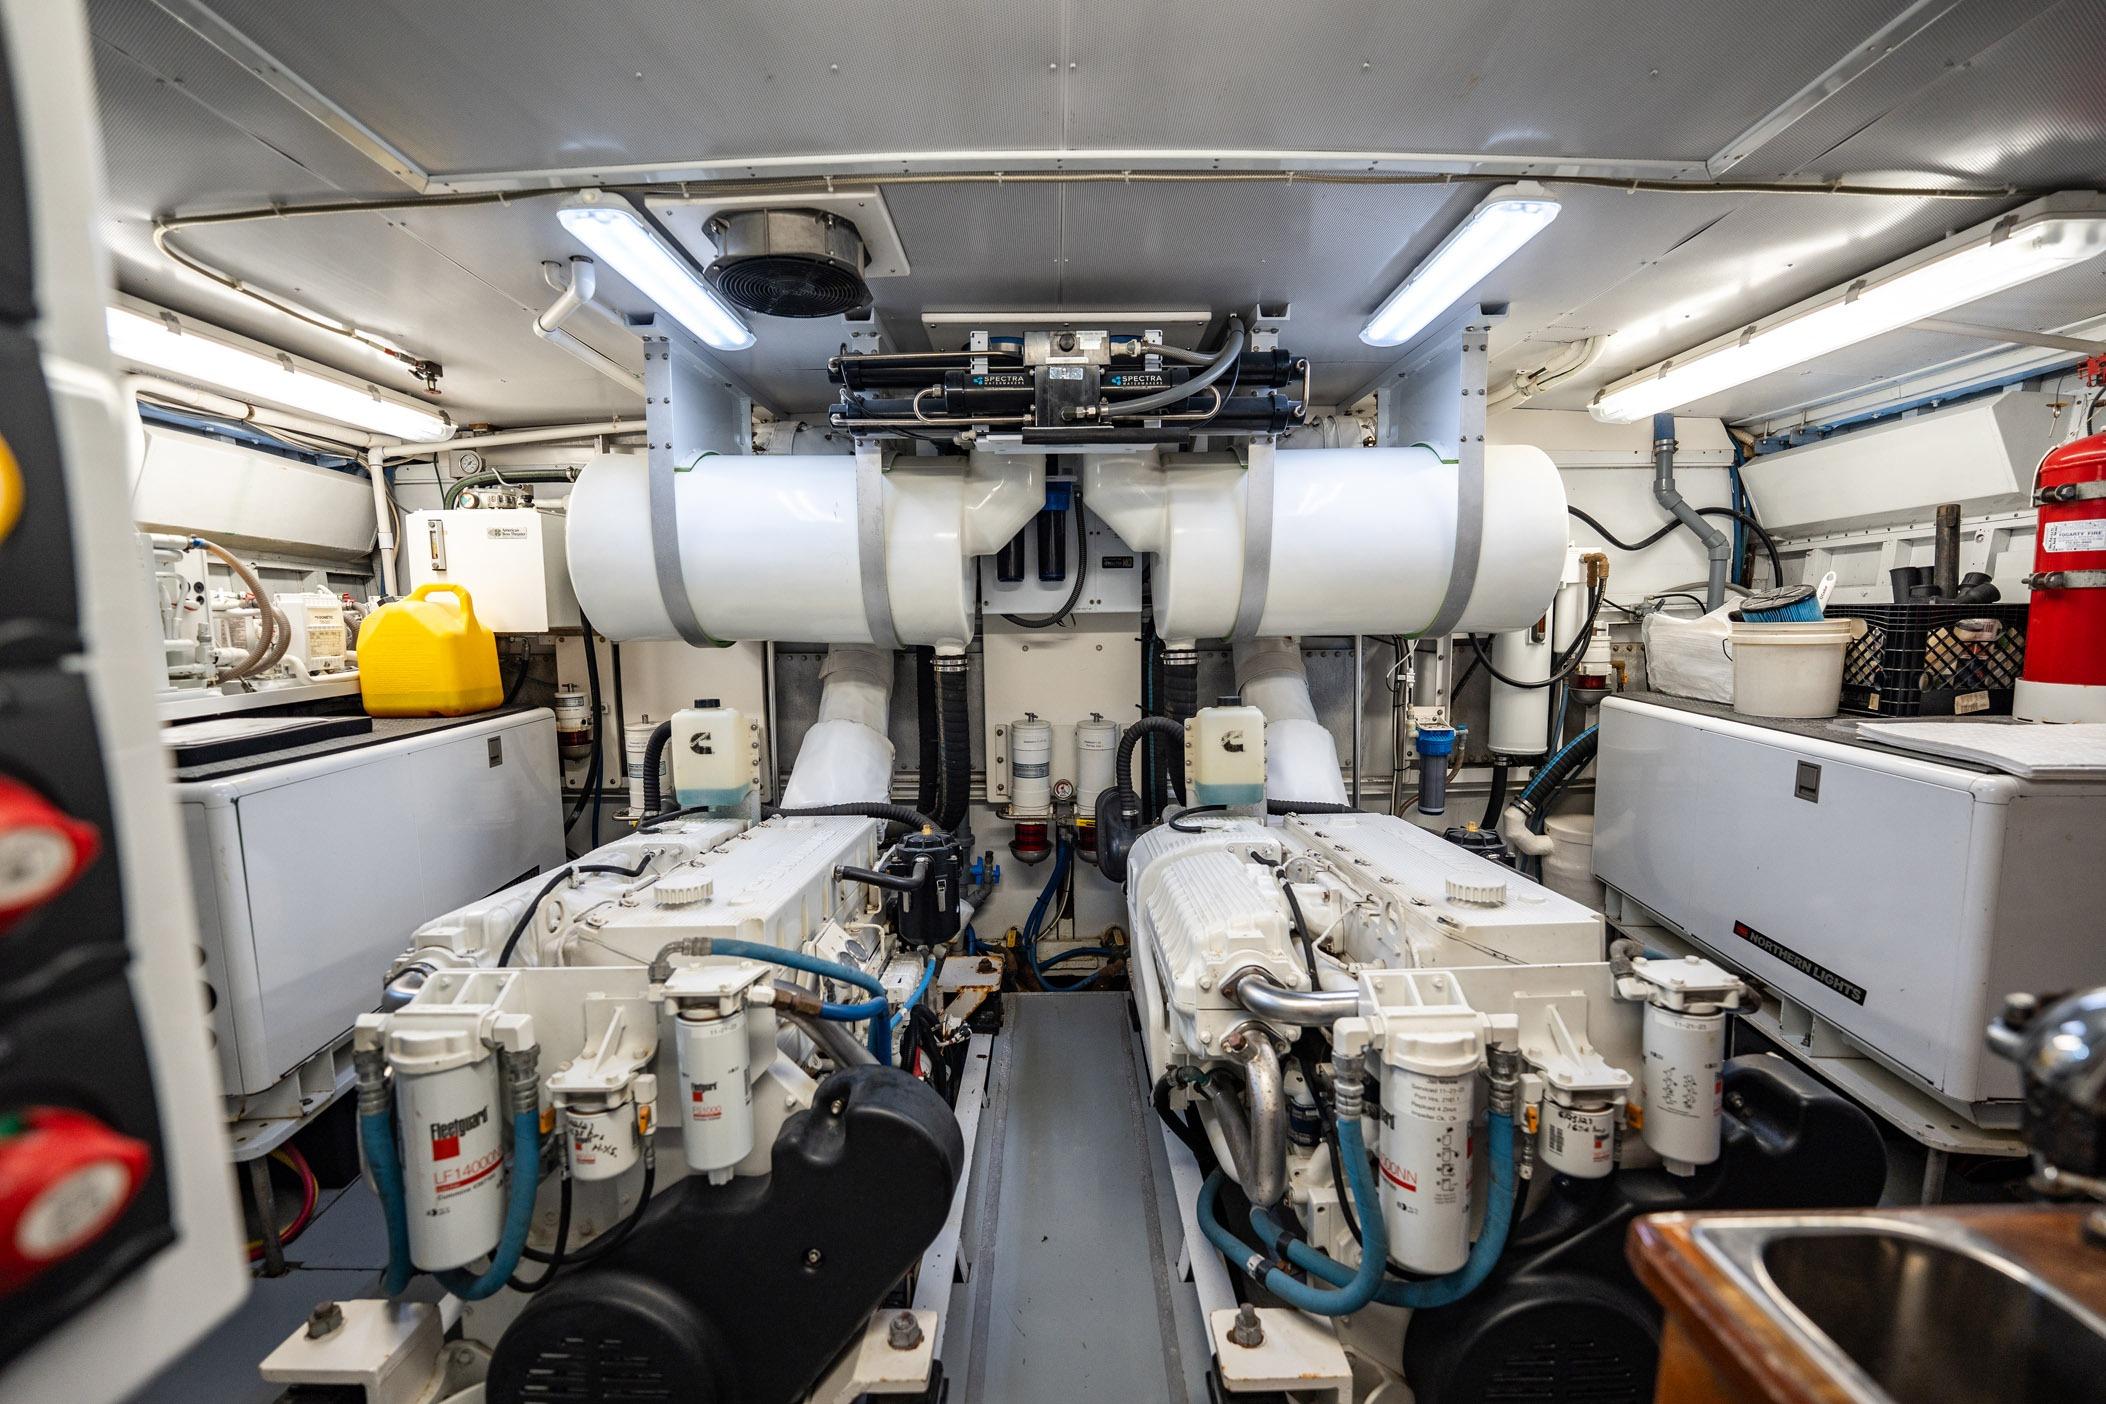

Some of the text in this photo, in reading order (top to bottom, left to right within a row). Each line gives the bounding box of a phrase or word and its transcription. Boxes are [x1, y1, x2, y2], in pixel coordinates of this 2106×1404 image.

[1749, 931, 1862, 1001] NORTHERN LIGHTS
[430, 1104, 489, 1140] Fleetguard
